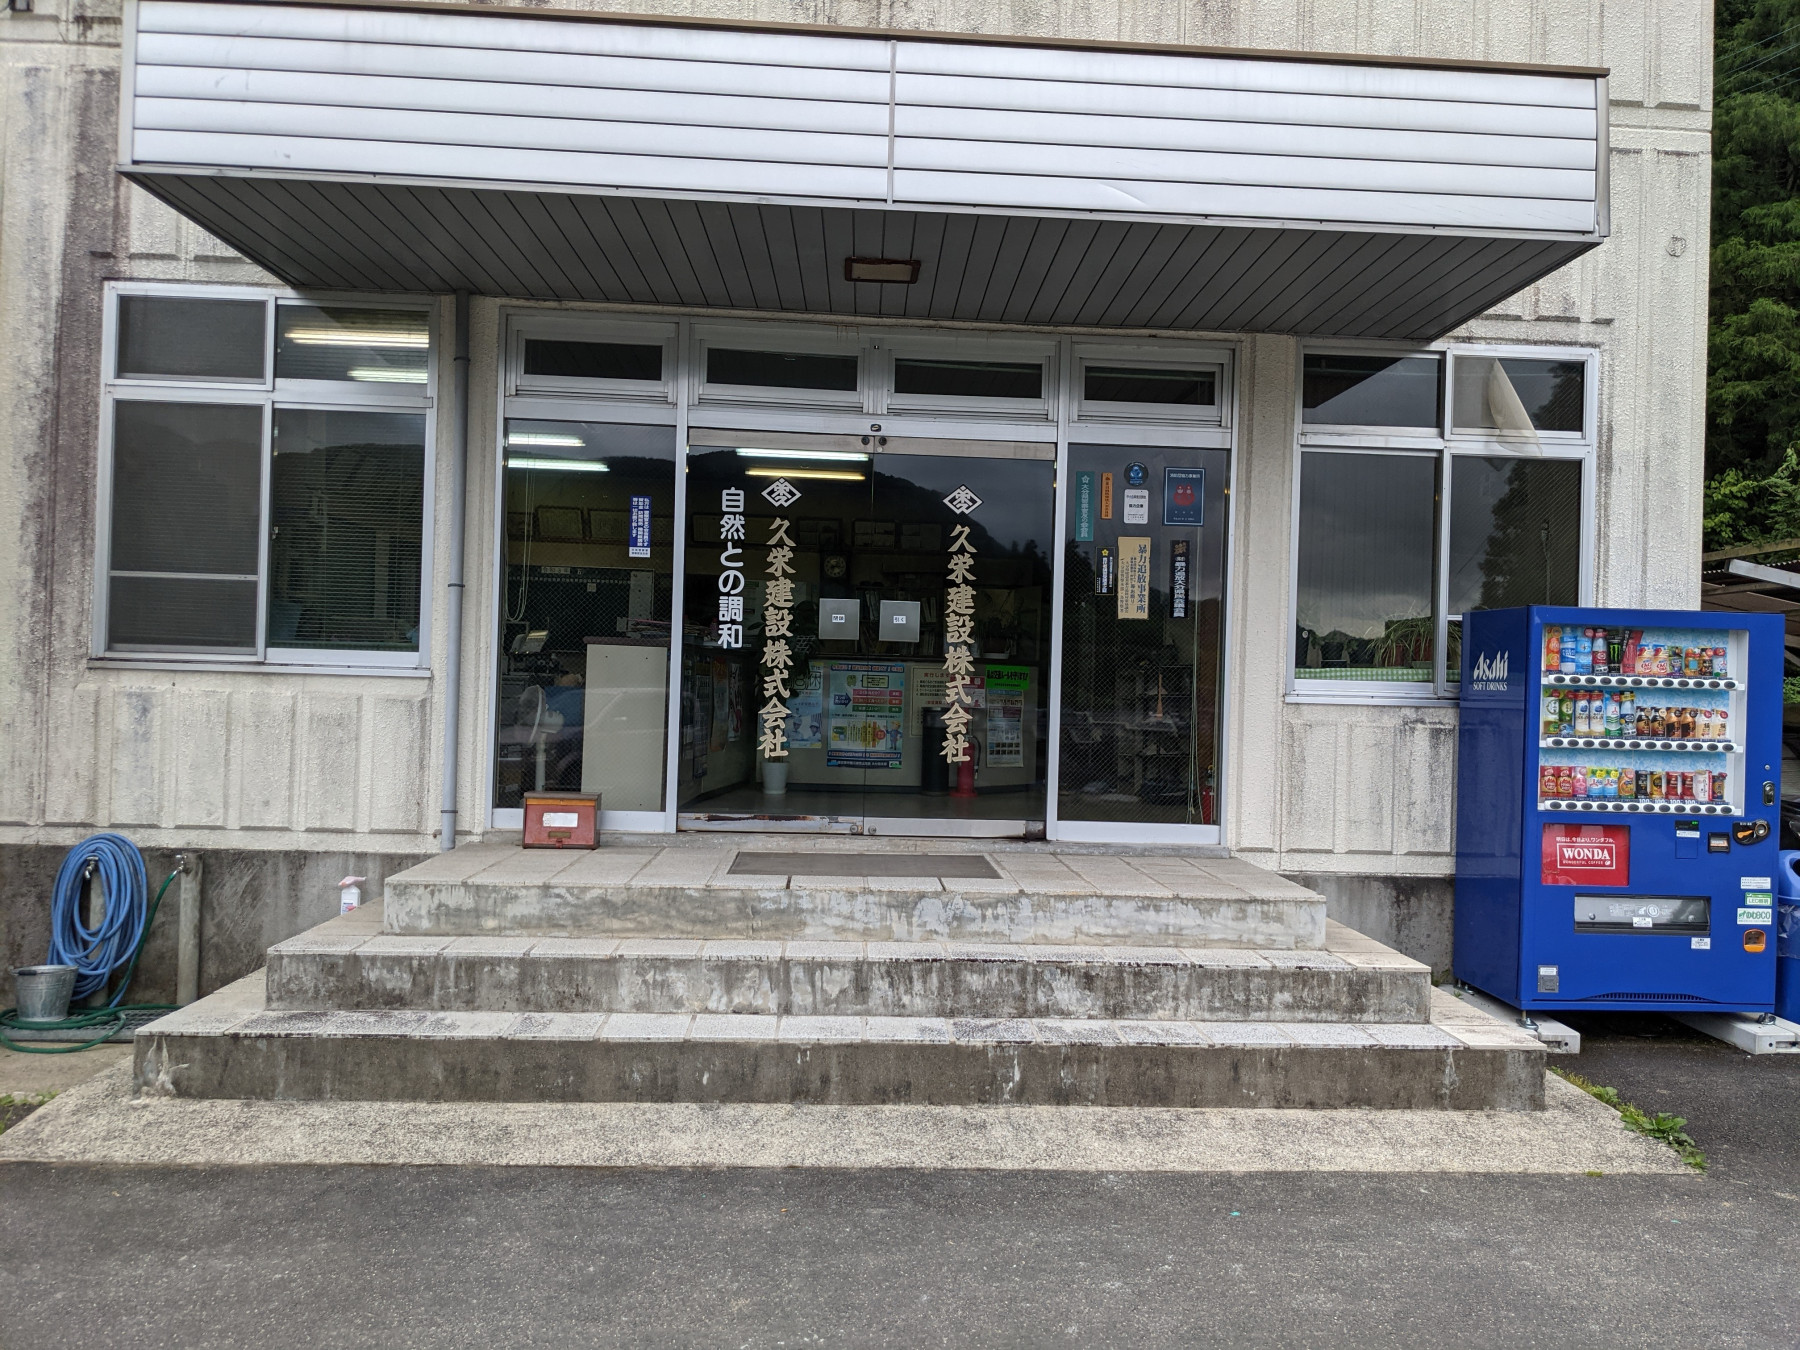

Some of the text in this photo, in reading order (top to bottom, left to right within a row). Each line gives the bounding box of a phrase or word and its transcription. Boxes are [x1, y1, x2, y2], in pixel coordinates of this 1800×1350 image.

[717, 487, 746, 650] 自然との調和
[1135, 543, 1148, 614] 暴力追放事業所
[757, 516, 797, 759] 久栄建設株式会社
[939, 523, 978, 764] 久栄建設株式会社
[1473, 650, 1509, 681] Asahi
[1472, 681, 1508, 691] SOFT DRINKS
[1562, 847, 1611, 860] WONDA
